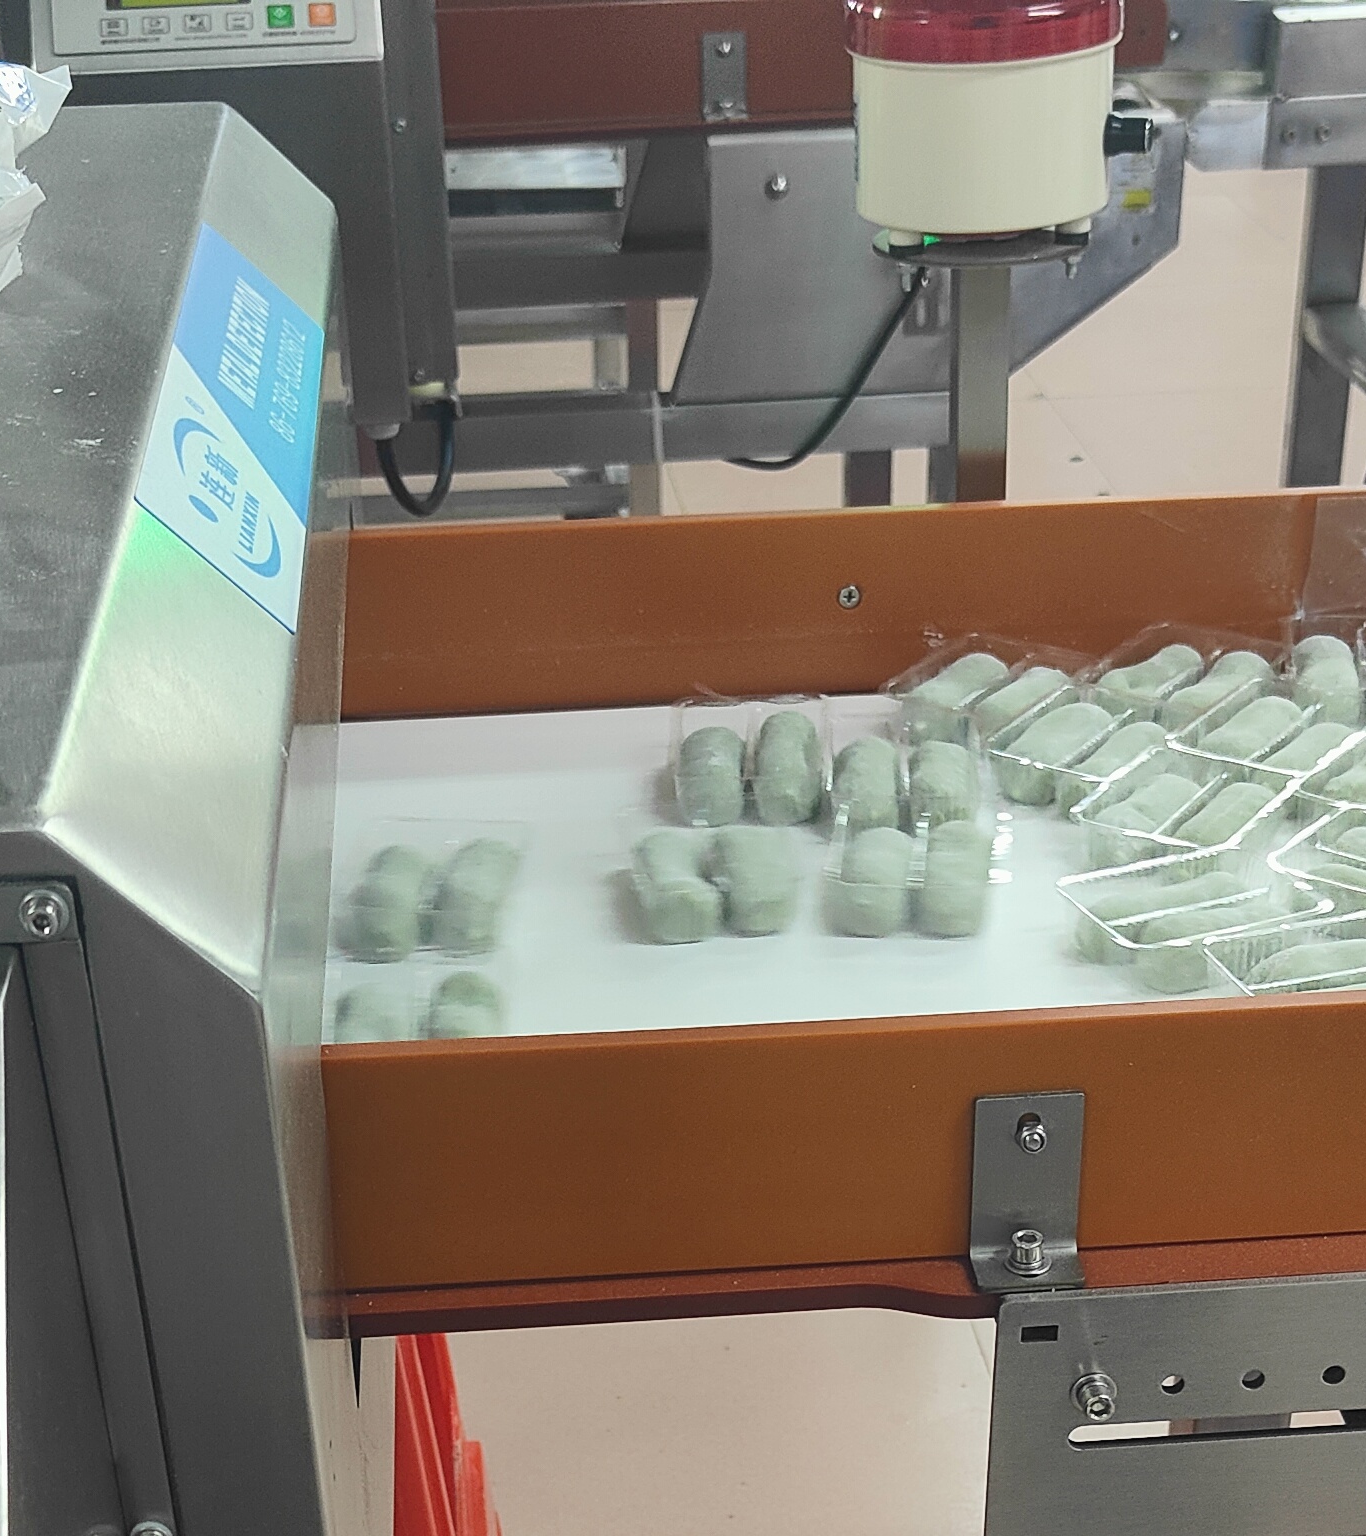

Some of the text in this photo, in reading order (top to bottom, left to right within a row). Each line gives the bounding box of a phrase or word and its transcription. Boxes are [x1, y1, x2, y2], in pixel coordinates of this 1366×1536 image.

[218, 275, 270, 410] METAL DETECTION
[199, 444, 239, 511] 连新
[238, 491, 261, 554] LIANXIN
